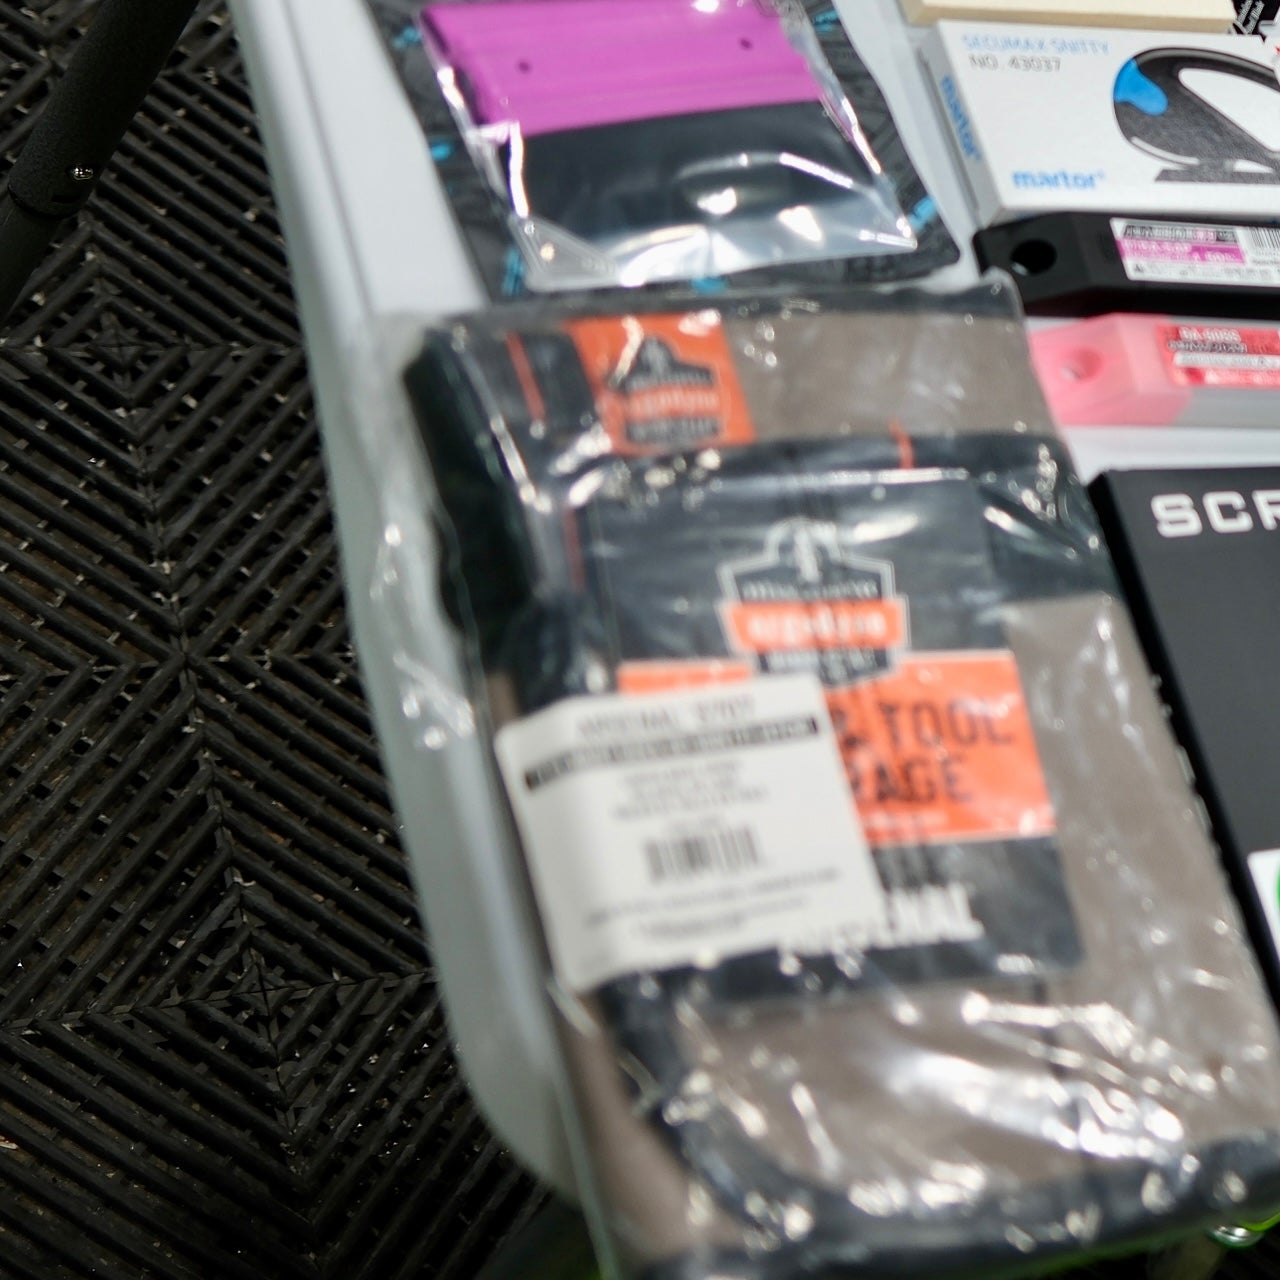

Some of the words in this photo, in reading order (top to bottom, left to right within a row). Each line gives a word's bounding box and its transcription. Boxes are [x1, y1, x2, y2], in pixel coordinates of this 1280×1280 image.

[961, 34, 1046, 53] SECUMAX
[1050, 37, 1112, 56] SNITTY
[1007, 55, 1062, 72] 43037
[1012, 171, 1098, 190] martor
